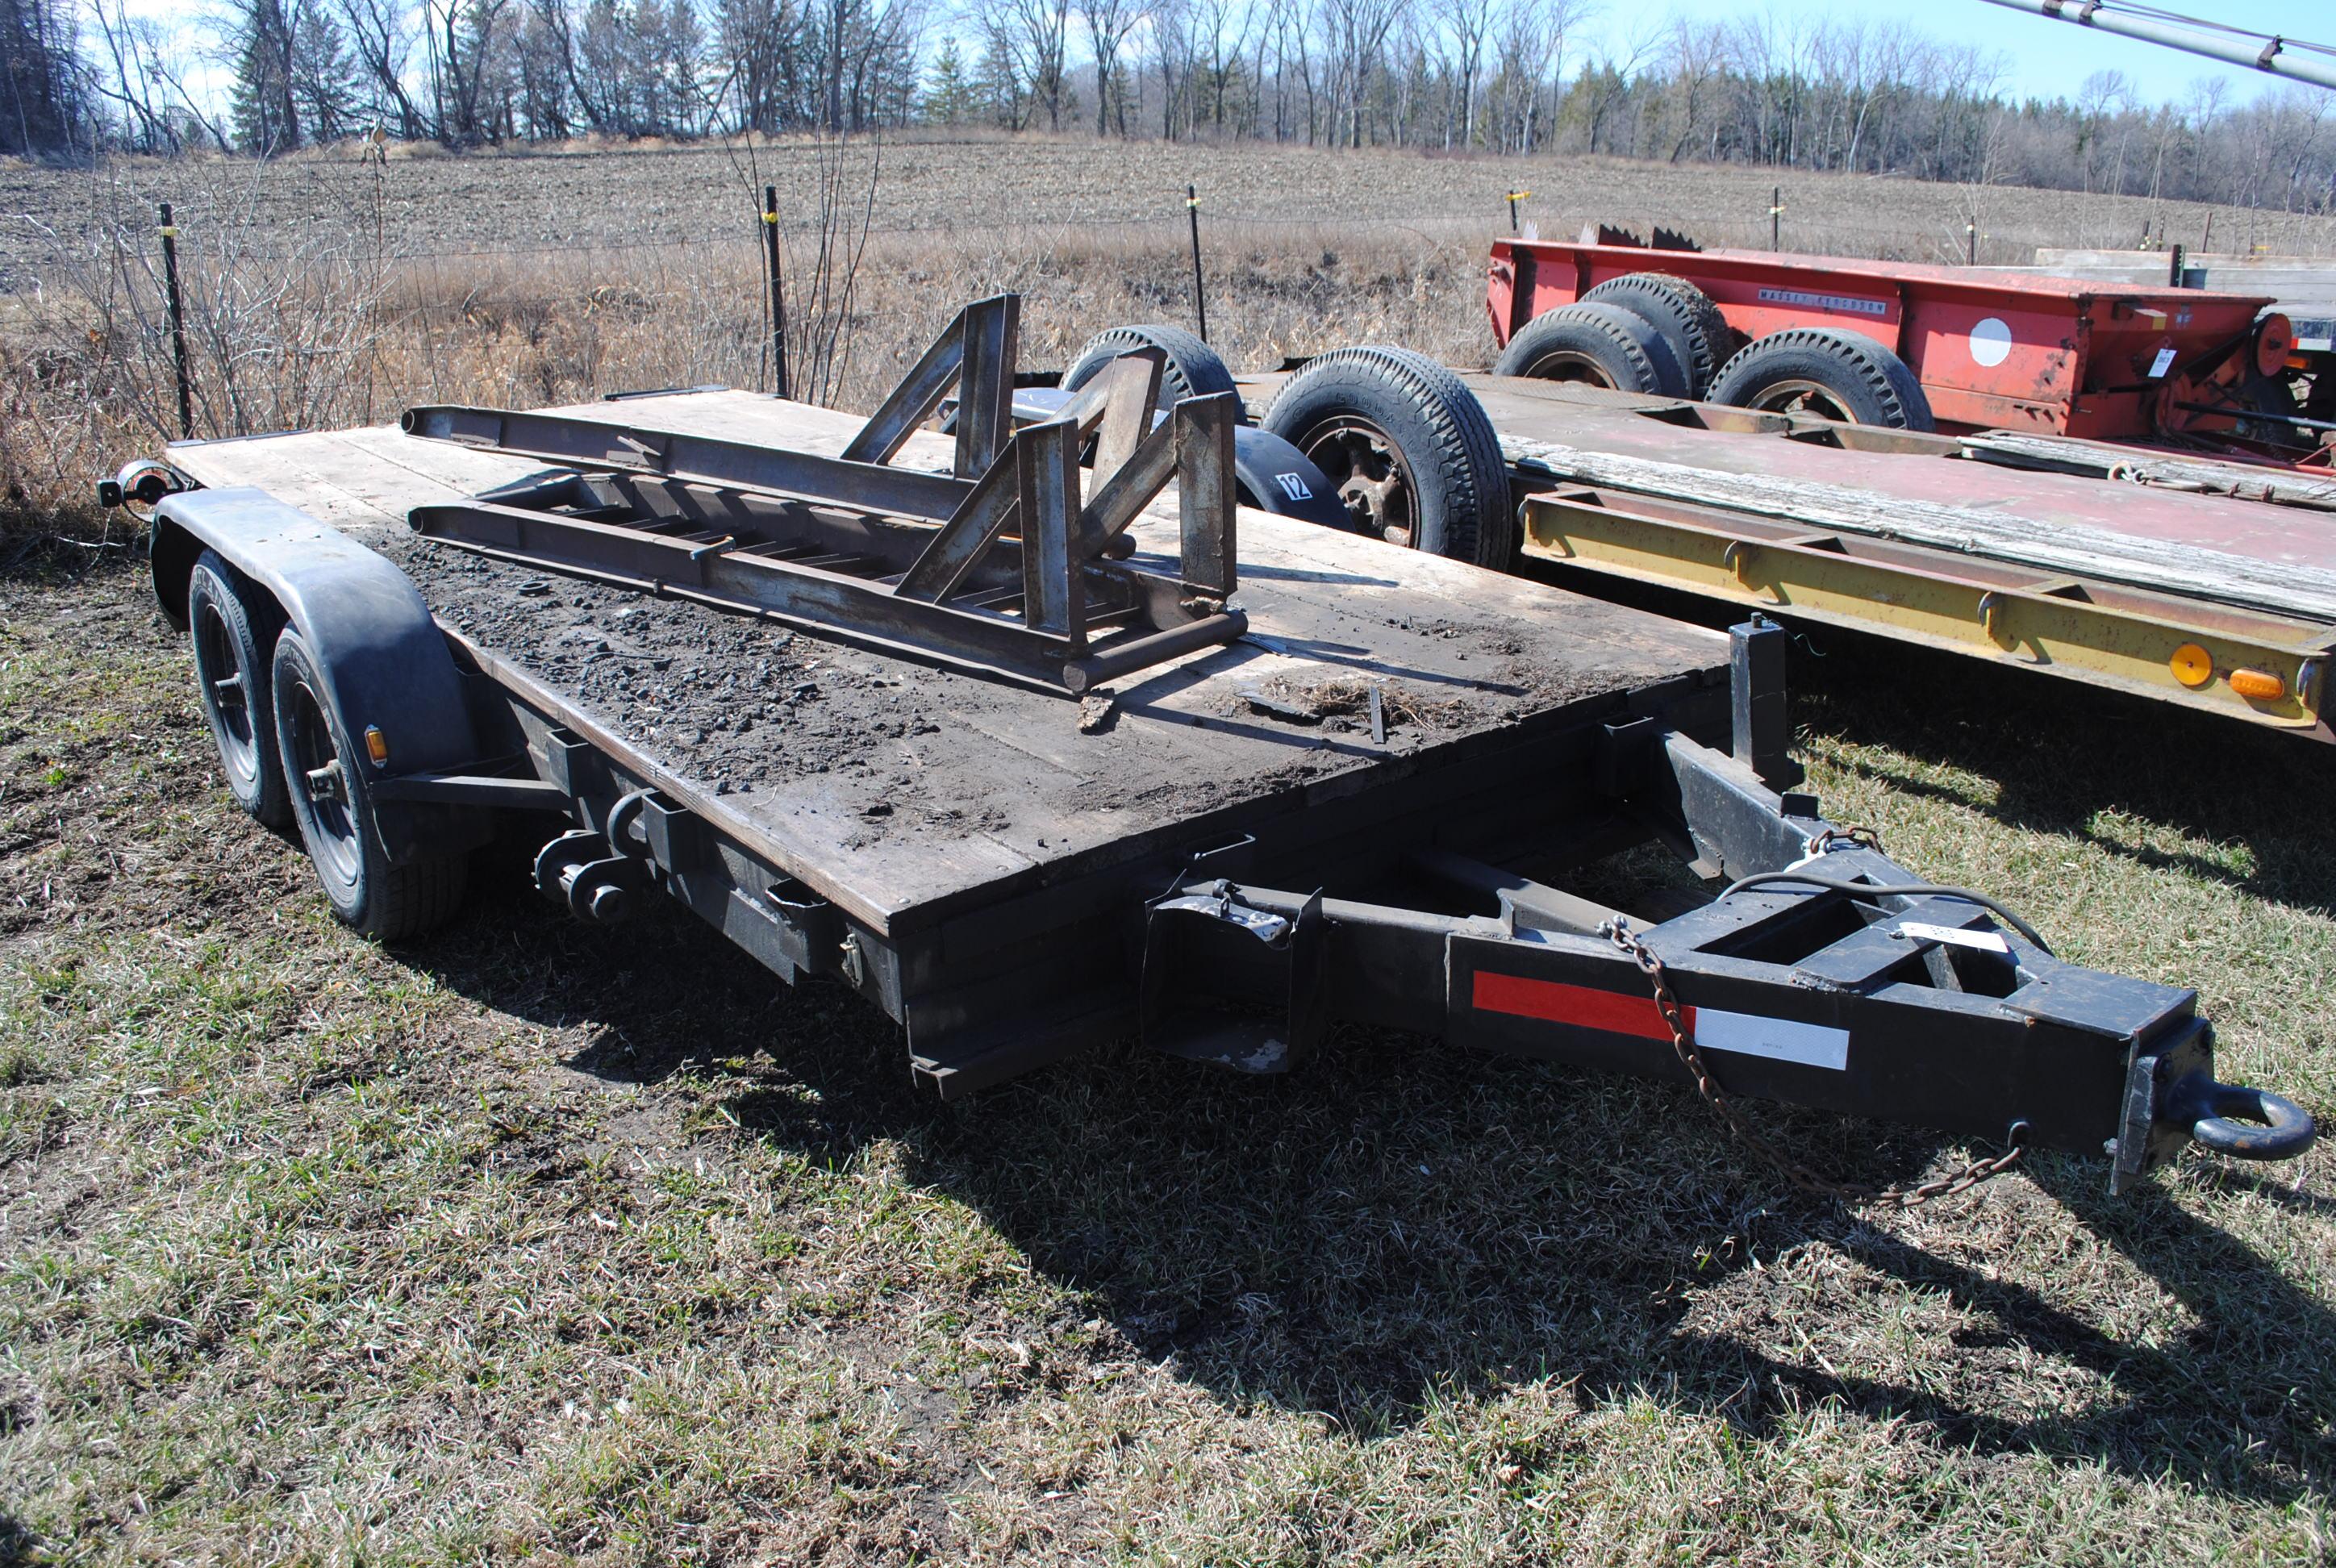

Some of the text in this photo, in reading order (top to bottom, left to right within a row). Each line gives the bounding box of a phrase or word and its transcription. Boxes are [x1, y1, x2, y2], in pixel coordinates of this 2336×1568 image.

[1760, 290, 1883, 311] MASSEY FERGUSON
[1279, 474, 1311, 498] 12
